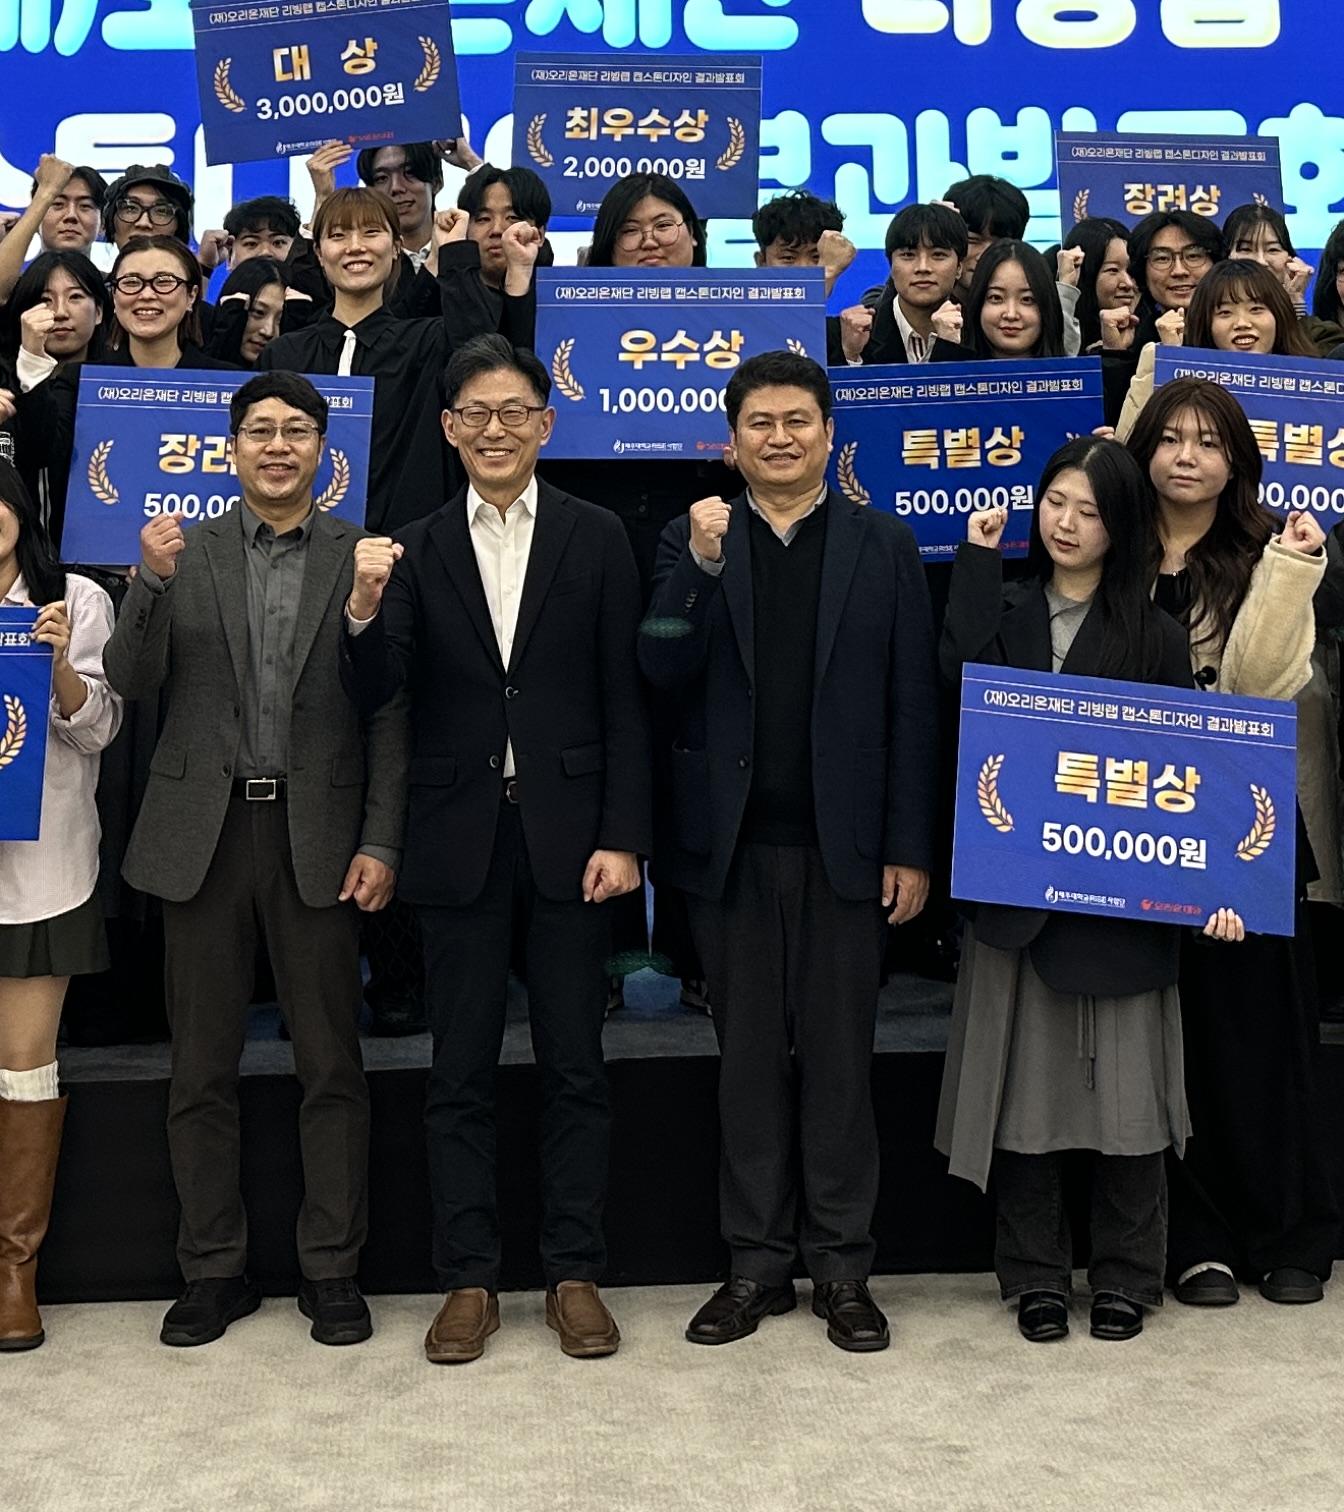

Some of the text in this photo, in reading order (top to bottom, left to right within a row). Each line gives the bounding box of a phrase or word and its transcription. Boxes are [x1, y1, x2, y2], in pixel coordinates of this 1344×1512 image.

[255, 82, 405, 121] 3,000,000원
[564, 106, 710, 144] 최우수상
[563, 157, 706, 180] 2,000000원
[1123, 183, 1222, 217] 장려상
[618, 329, 745, 370] 우수상
[901, 425, 1025, 470] 특별상
[895, 484, 1035, 516] 500,000원
[1054, 750, 1202, 814] 특별상
[1041, 821, 1208, 870] 500,000원
